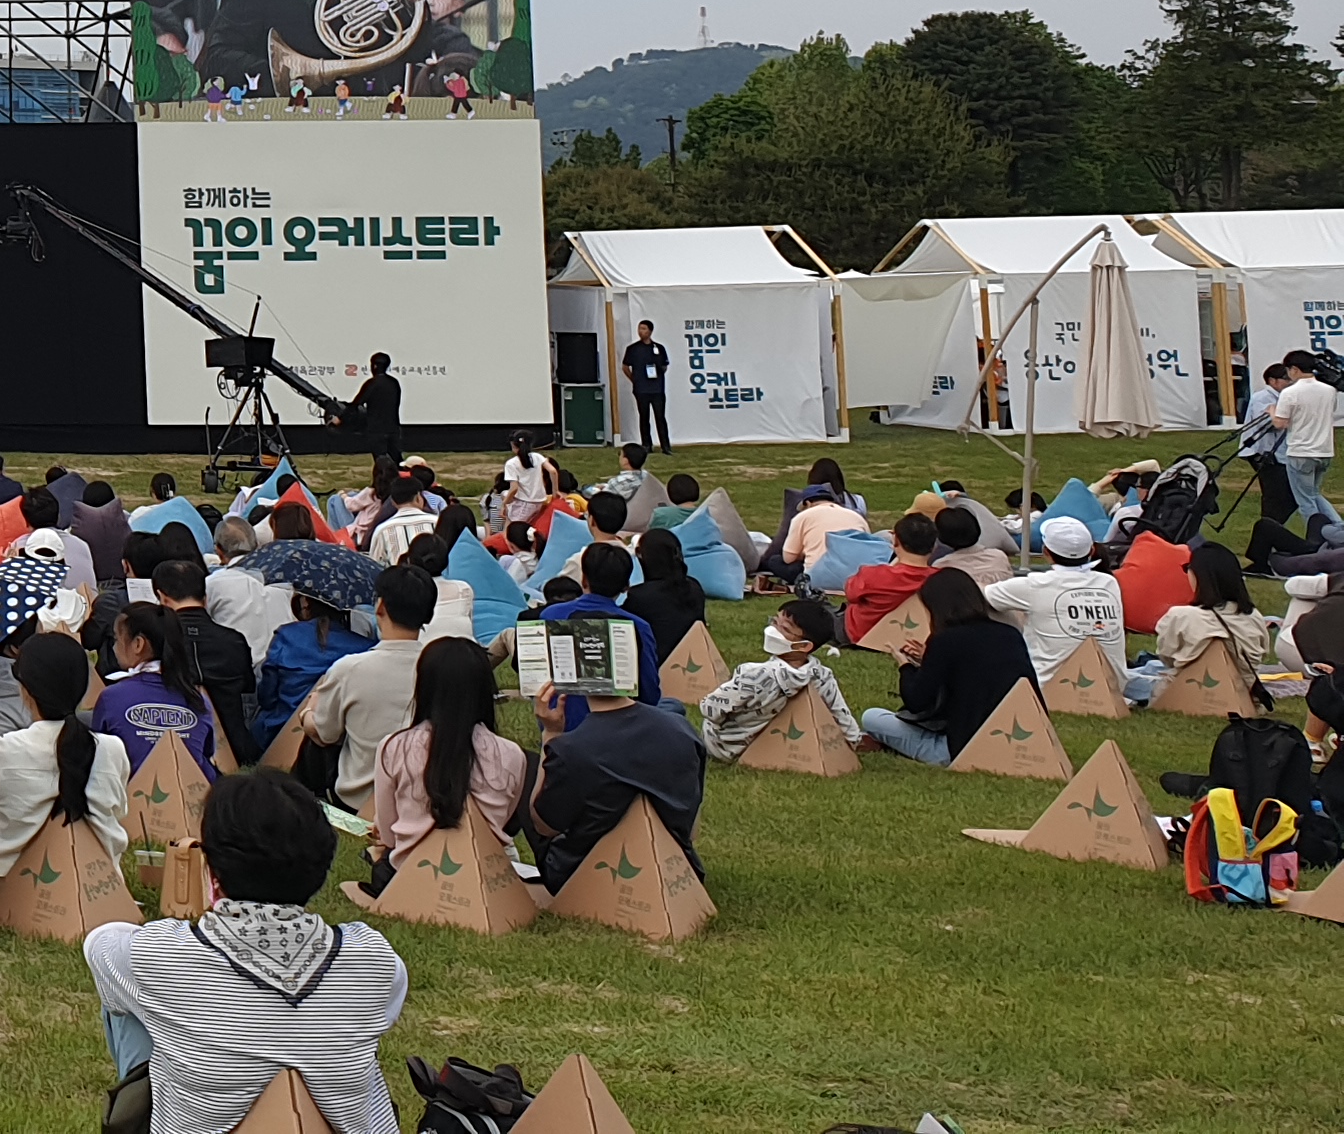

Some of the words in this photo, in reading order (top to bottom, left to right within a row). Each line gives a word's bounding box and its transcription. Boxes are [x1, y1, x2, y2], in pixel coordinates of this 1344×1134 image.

[183, 187, 272, 209] 함께하는
[184, 216, 273, 294] 꿈의
[283, 216, 501, 261] 오케스트라
[684, 319, 726, 330] 함께하는
[1055, 322, 1081, 345] 국민
[684, 333, 726, 369] 꿈의
[689, 372, 737, 393] 오케
[708, 387, 764, 409] 스트라
